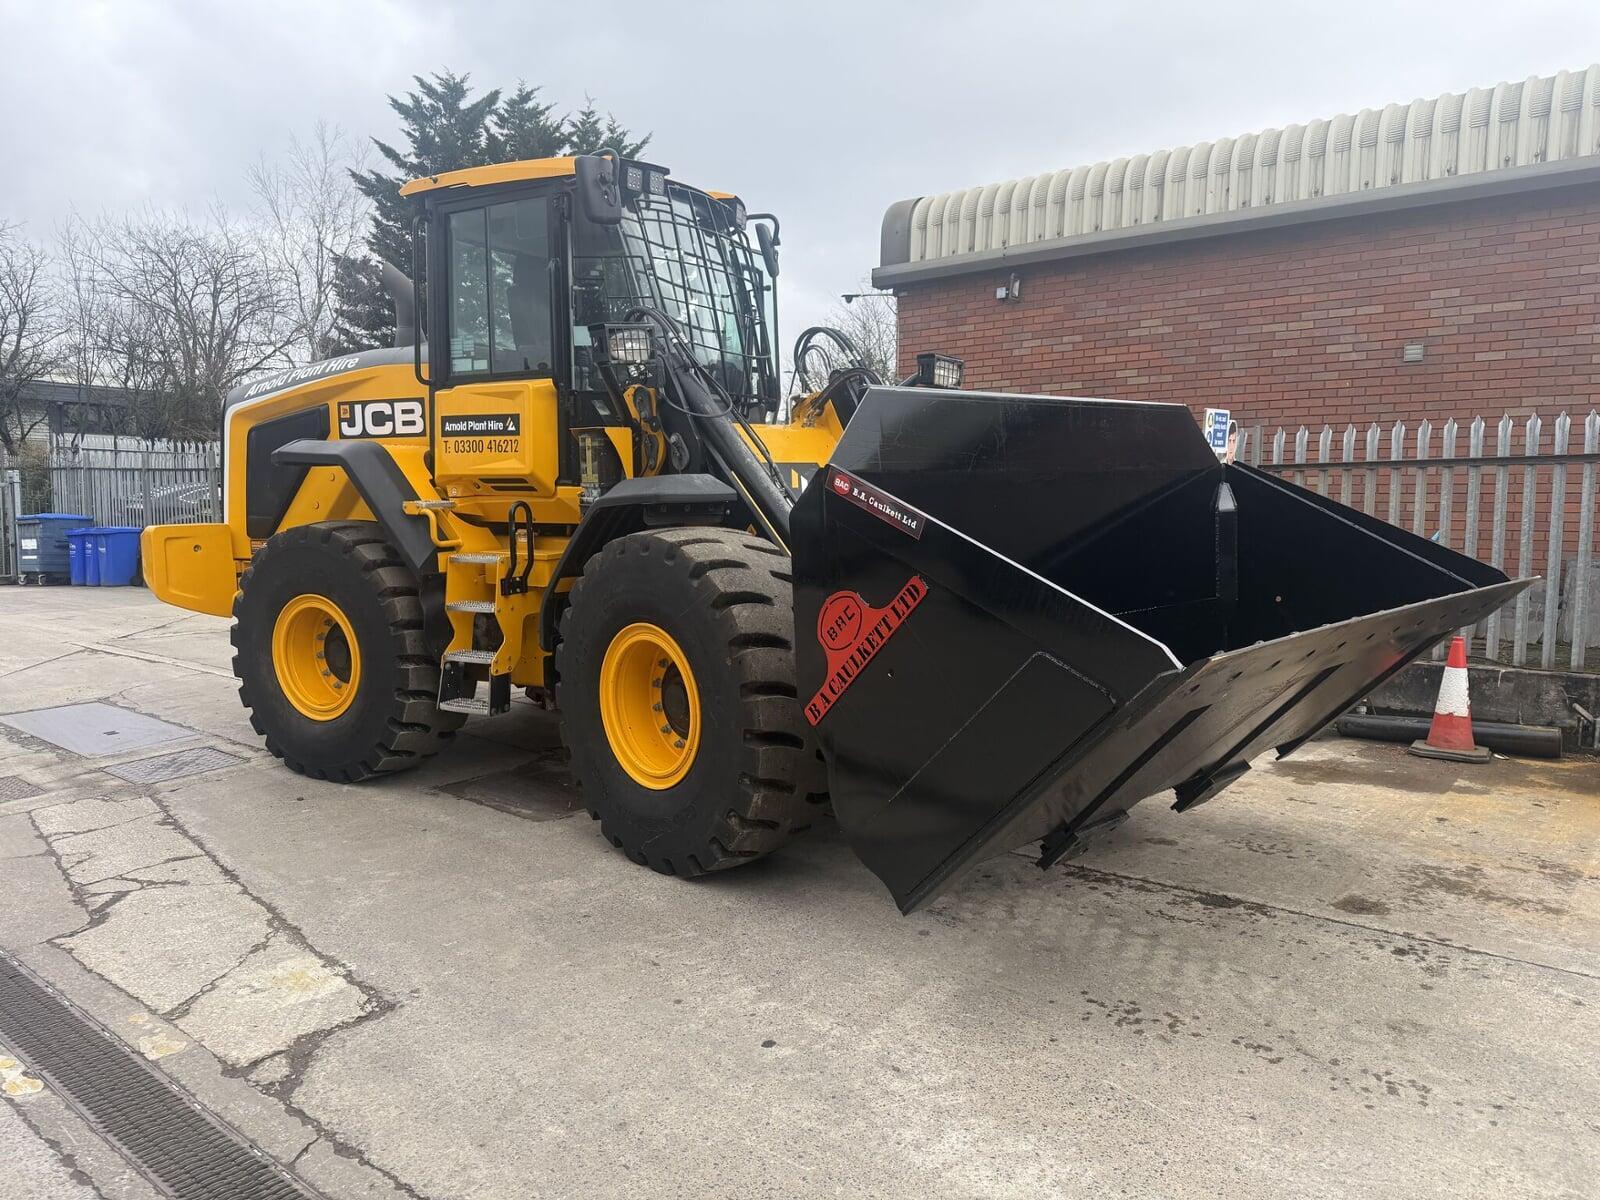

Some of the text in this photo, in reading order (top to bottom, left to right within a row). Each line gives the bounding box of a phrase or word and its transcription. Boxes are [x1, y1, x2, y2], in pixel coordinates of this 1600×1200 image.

[244, 357, 360, 398] Arnold Plant Hire
[340, 401, 425, 436] JCB
[445, 420, 504, 431] Arnold Plant Hire
[443, 439, 519, 454] T: 03300 416212
[902, 514, 917, 529] Ltd
[808, 583, 920, 721] B A CAULKETT LTD
